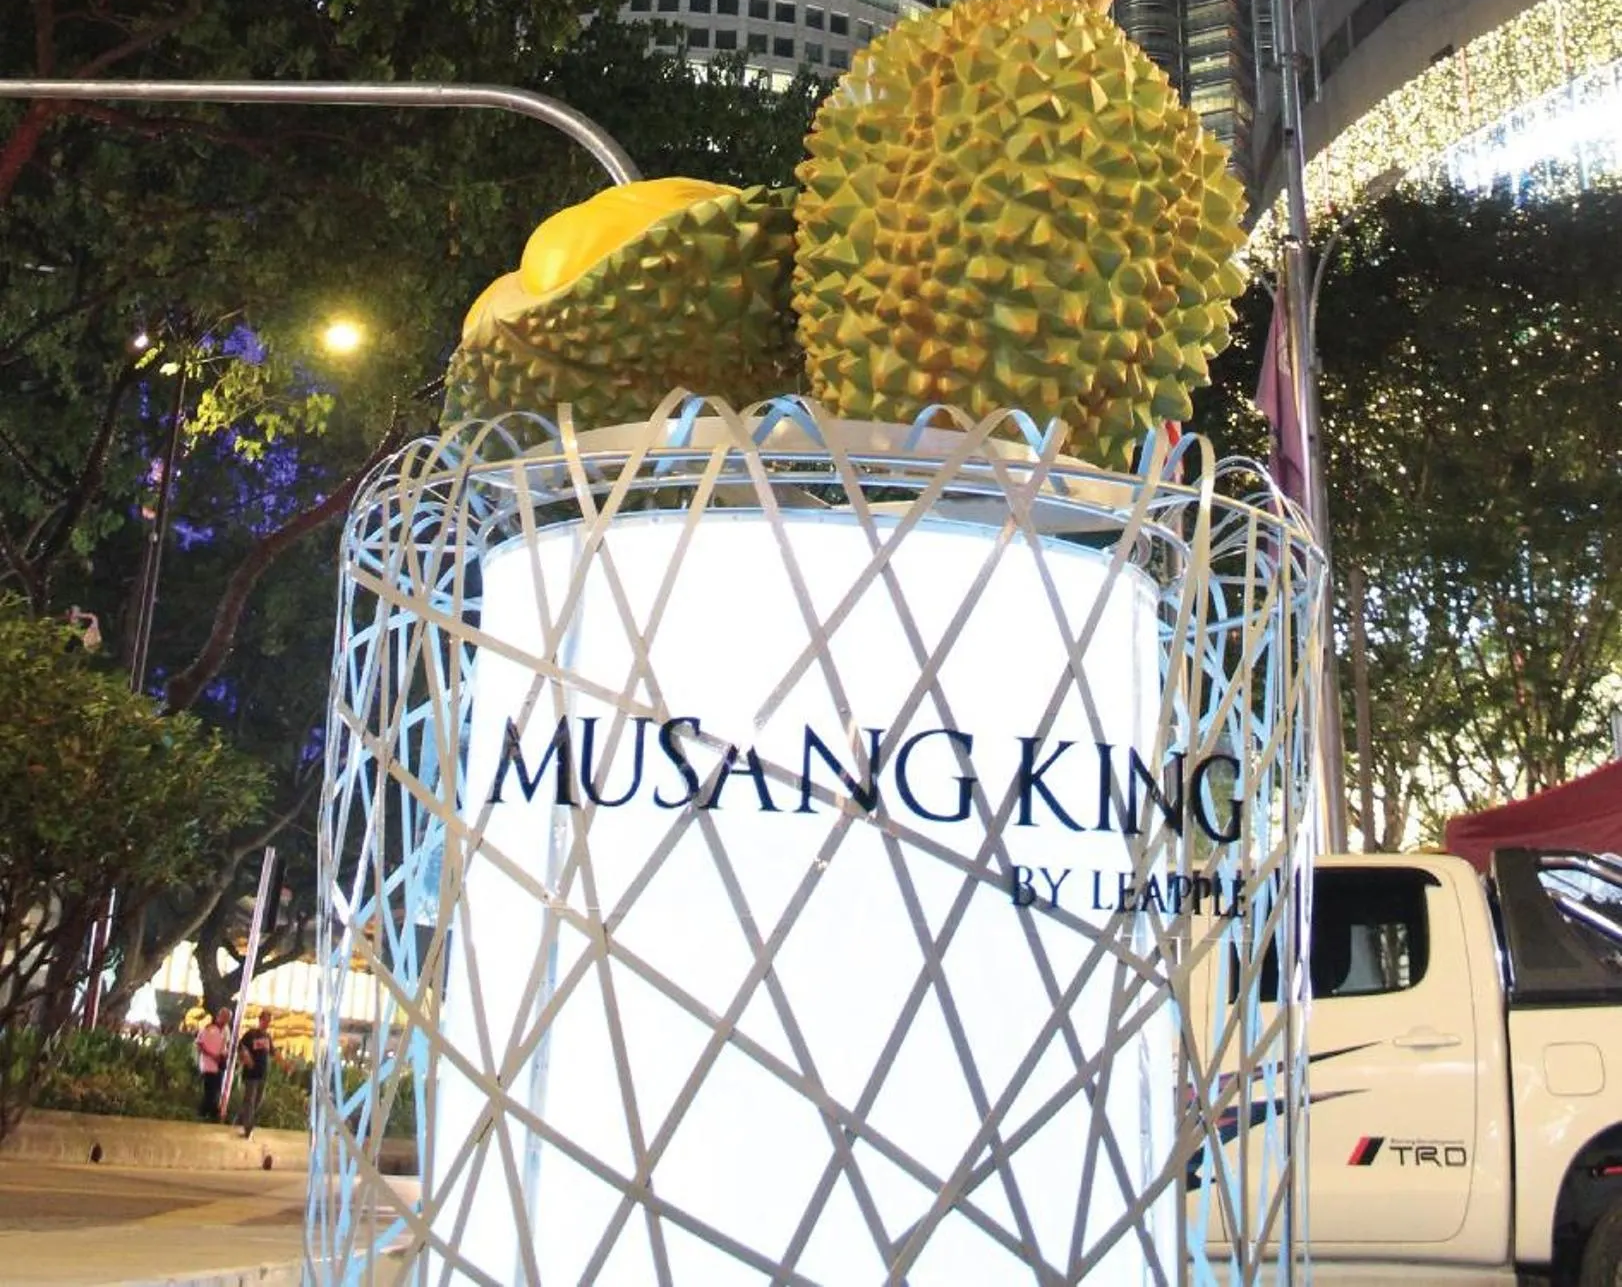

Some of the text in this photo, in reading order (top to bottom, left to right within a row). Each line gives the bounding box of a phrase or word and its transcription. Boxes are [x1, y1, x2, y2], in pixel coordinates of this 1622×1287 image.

[487, 714, 1244, 844] MUSANG KING
[1012, 865, 1247, 918] BY LEAPPLE
[1388, 1145, 1468, 1168] TRD
